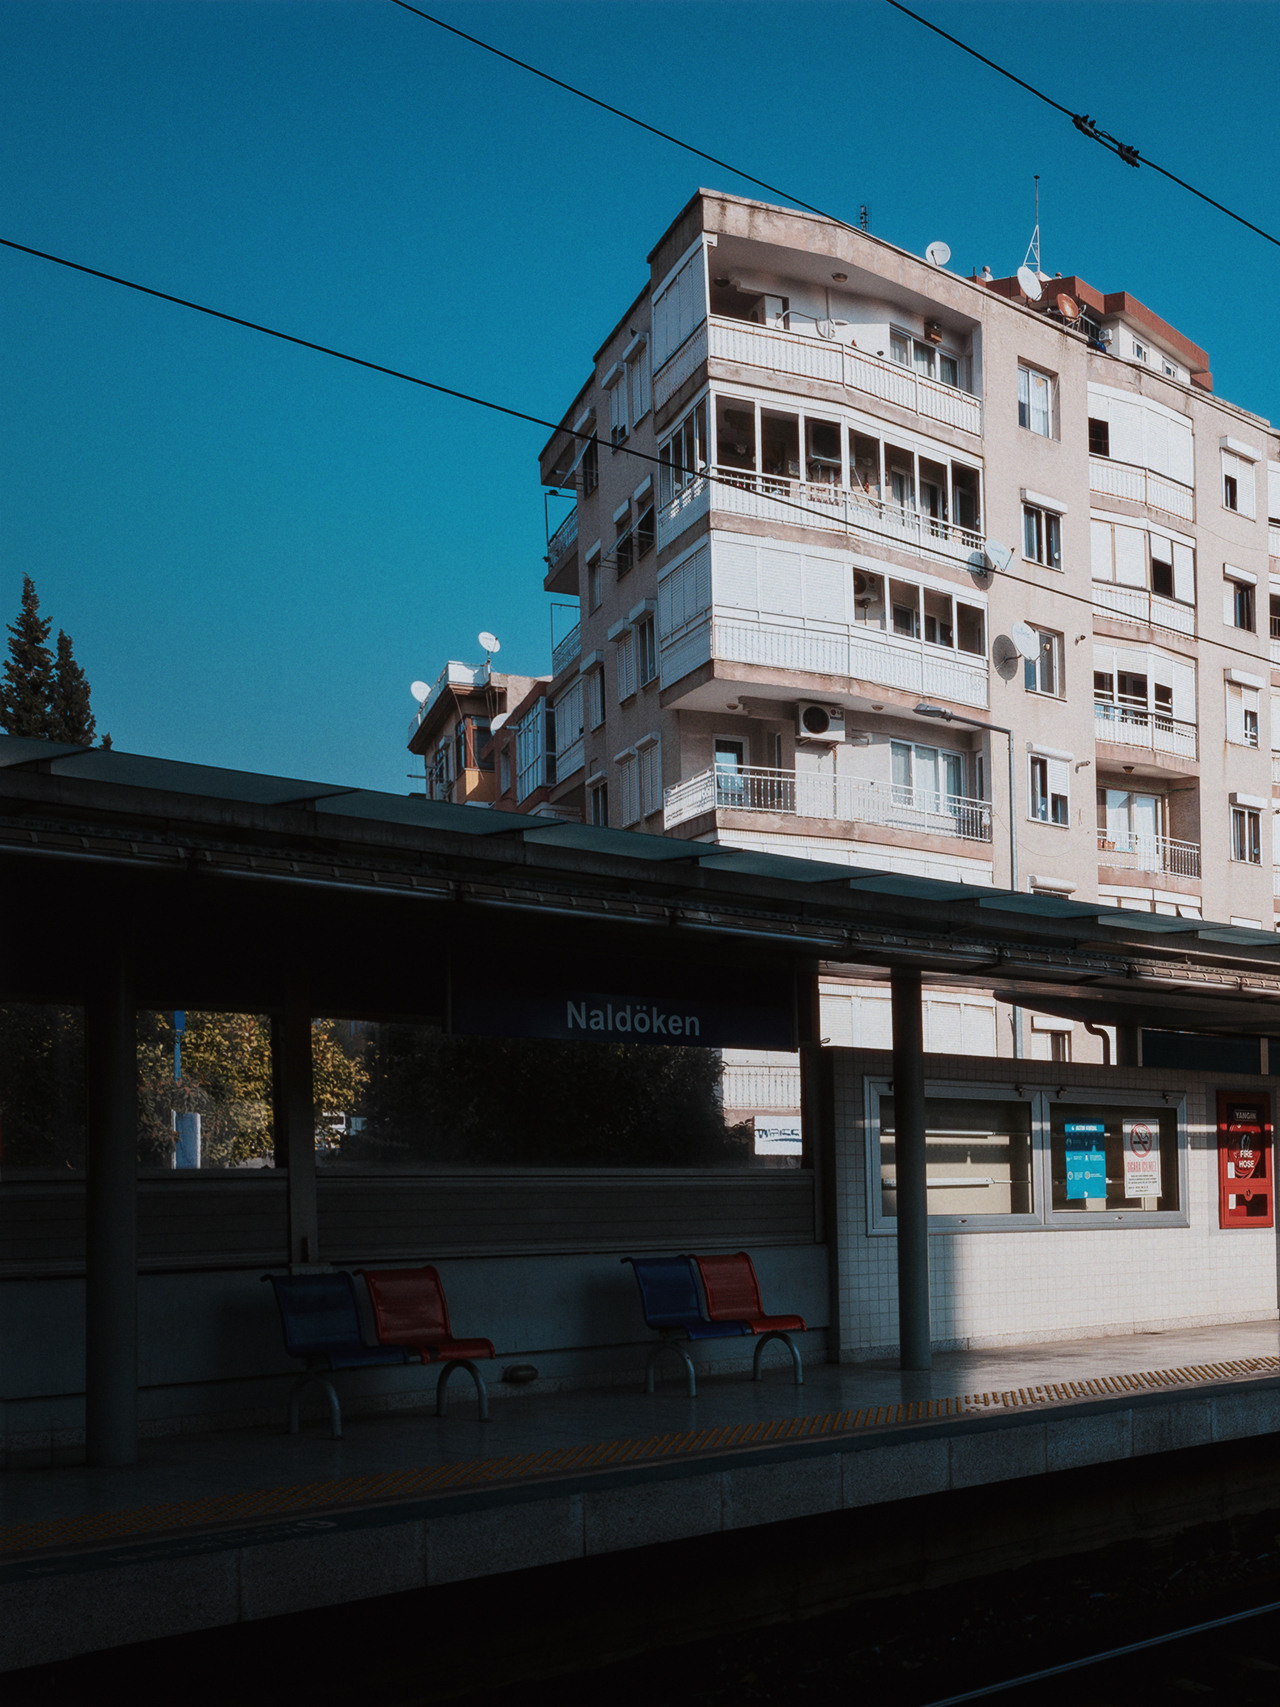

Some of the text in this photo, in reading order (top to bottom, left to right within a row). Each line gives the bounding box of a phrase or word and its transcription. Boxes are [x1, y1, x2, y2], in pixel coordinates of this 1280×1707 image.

[566, 1000, 701, 1037] Naldöken
[1240, 1150, 1253, 1158] FIRE
[1238, 1160, 1255, 1168] HOSE
